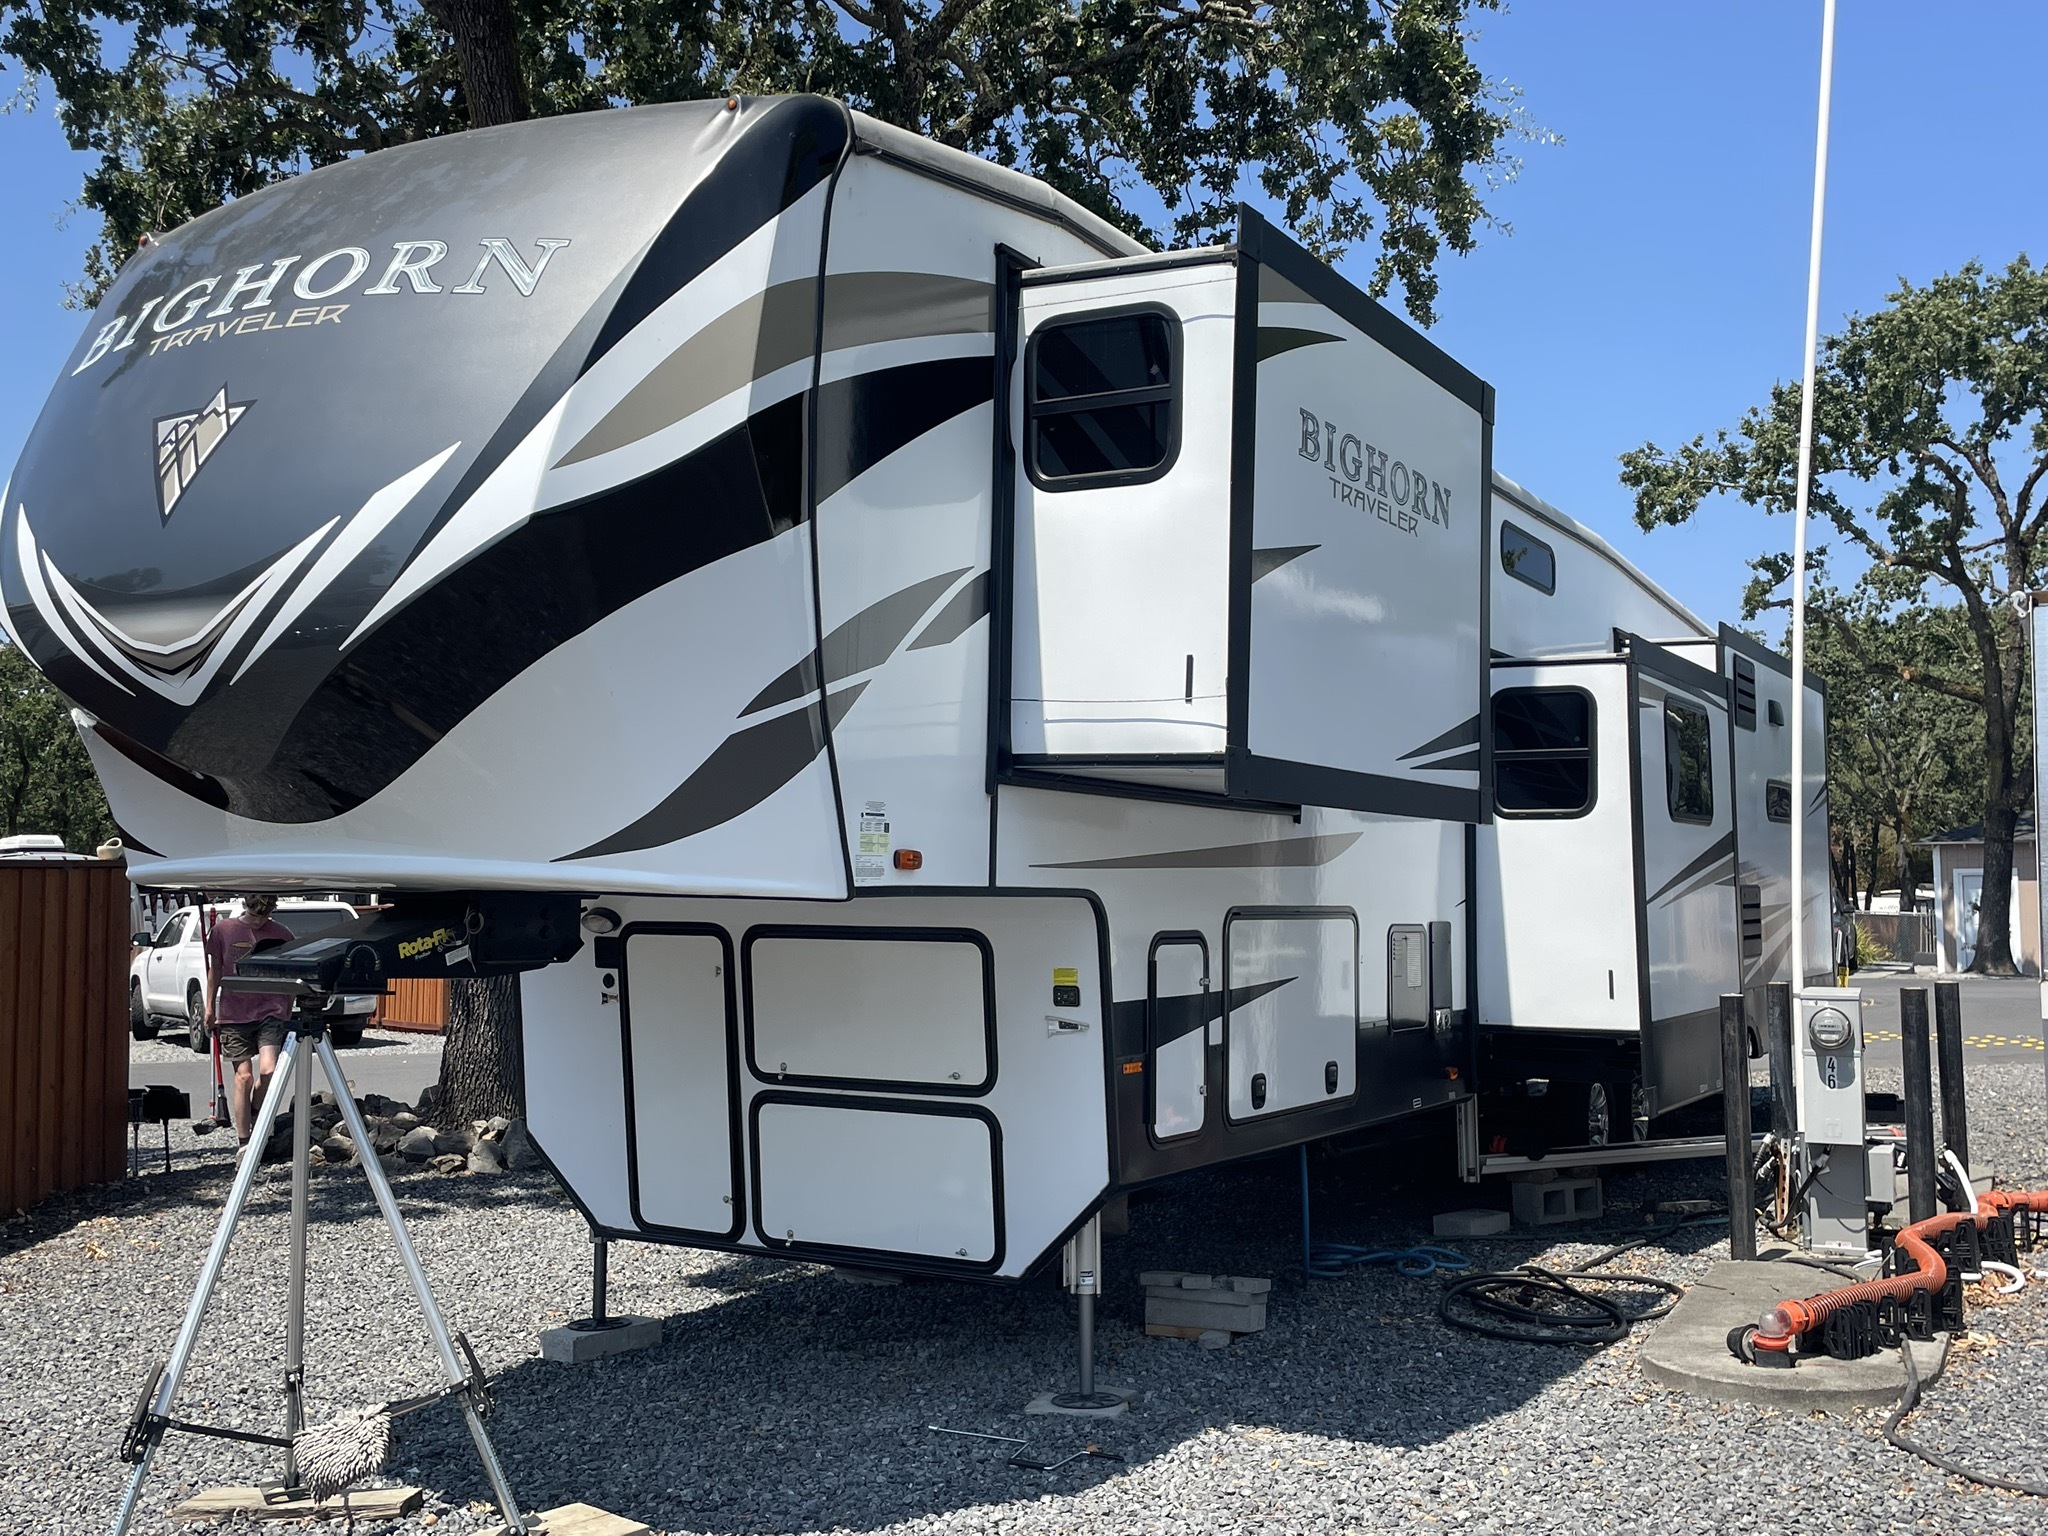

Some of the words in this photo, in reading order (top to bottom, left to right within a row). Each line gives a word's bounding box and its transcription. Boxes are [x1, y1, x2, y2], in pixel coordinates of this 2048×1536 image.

[70, 236, 573, 377] BIGHORN
[149, 303, 351, 356] TRAVELER
[1298, 406, 1452, 530] BIGHORN
[1328, 476, 1419, 538] TRAVELER
